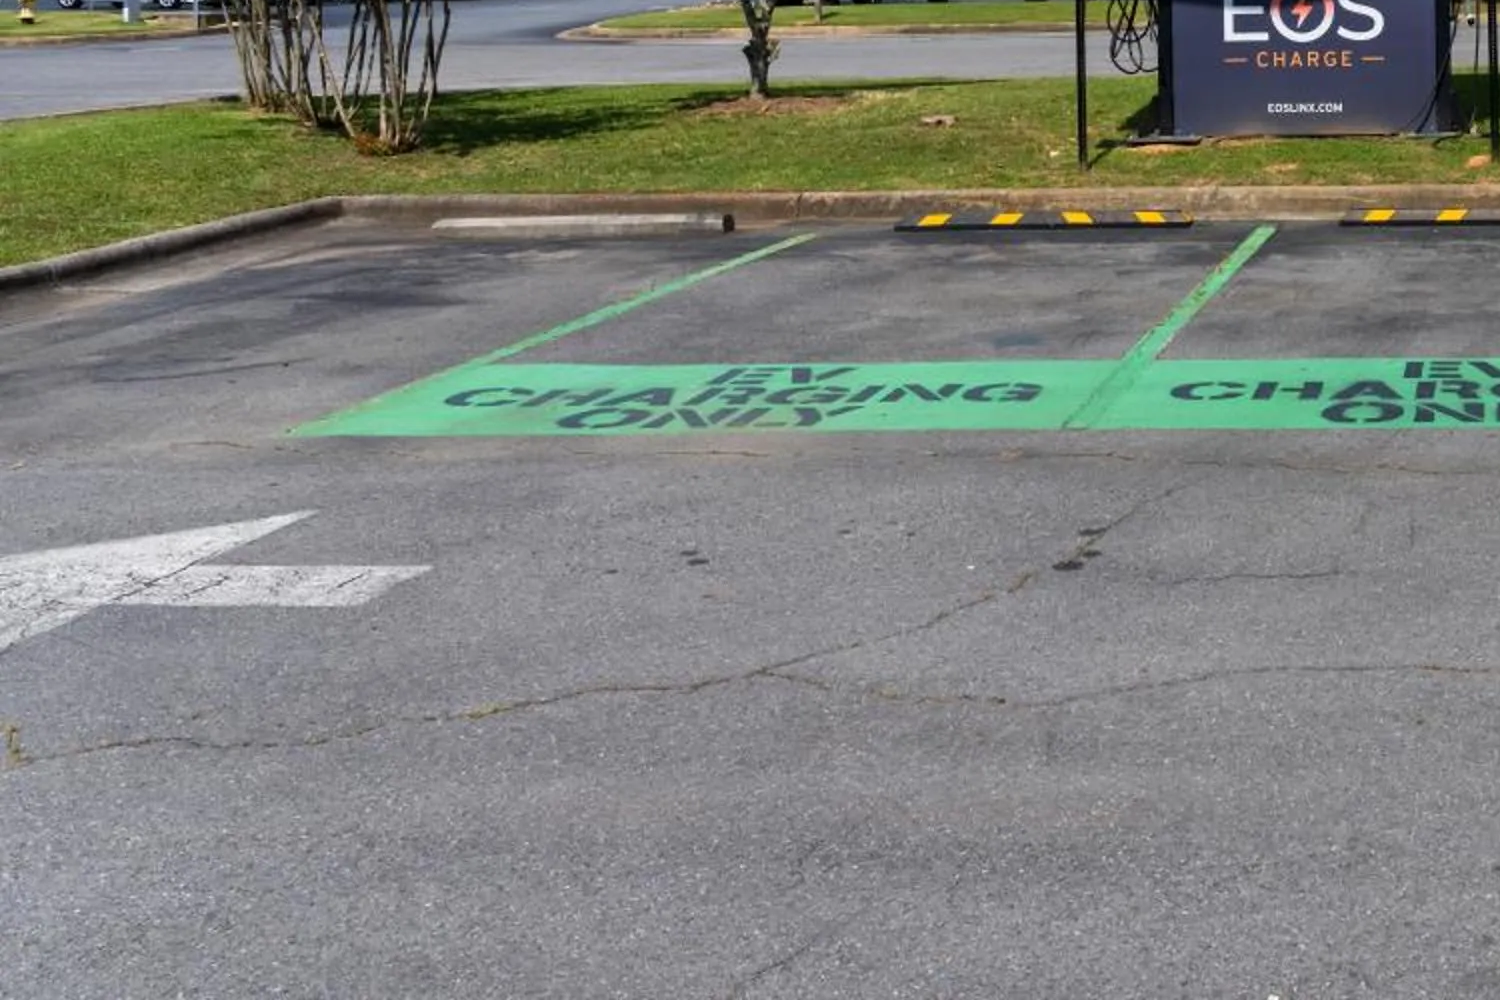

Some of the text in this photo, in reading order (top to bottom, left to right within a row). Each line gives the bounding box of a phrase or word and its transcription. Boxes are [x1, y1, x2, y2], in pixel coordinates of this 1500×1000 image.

[1256, 51, 1353, 68] CHARGE
[1267, 102, 1343, 113] EOSLINX.COM
[705, 367, 859, 385] EV
[444, 383, 1044, 407] CHARGING
[554, 406, 865, 429] ONLY
